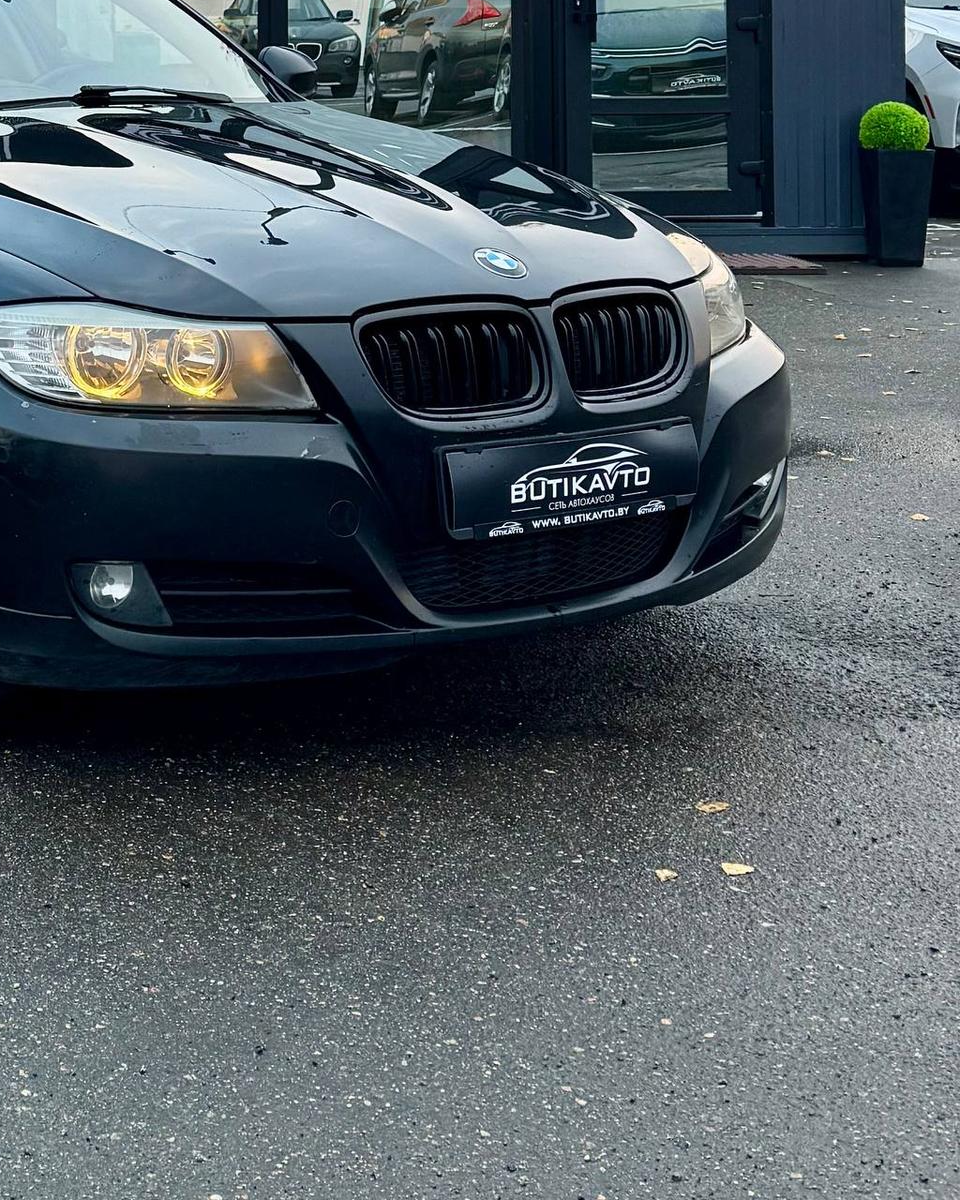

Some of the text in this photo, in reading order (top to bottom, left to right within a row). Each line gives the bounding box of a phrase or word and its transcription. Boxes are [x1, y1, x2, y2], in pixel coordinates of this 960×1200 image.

[510, 466, 651, 504] BUTIKAVTO
[548, 494, 615, 511] СЕТЬ АВТОХАУСОВ
[531, 506, 630, 529] WWW. BUTIKAVTO.BY
